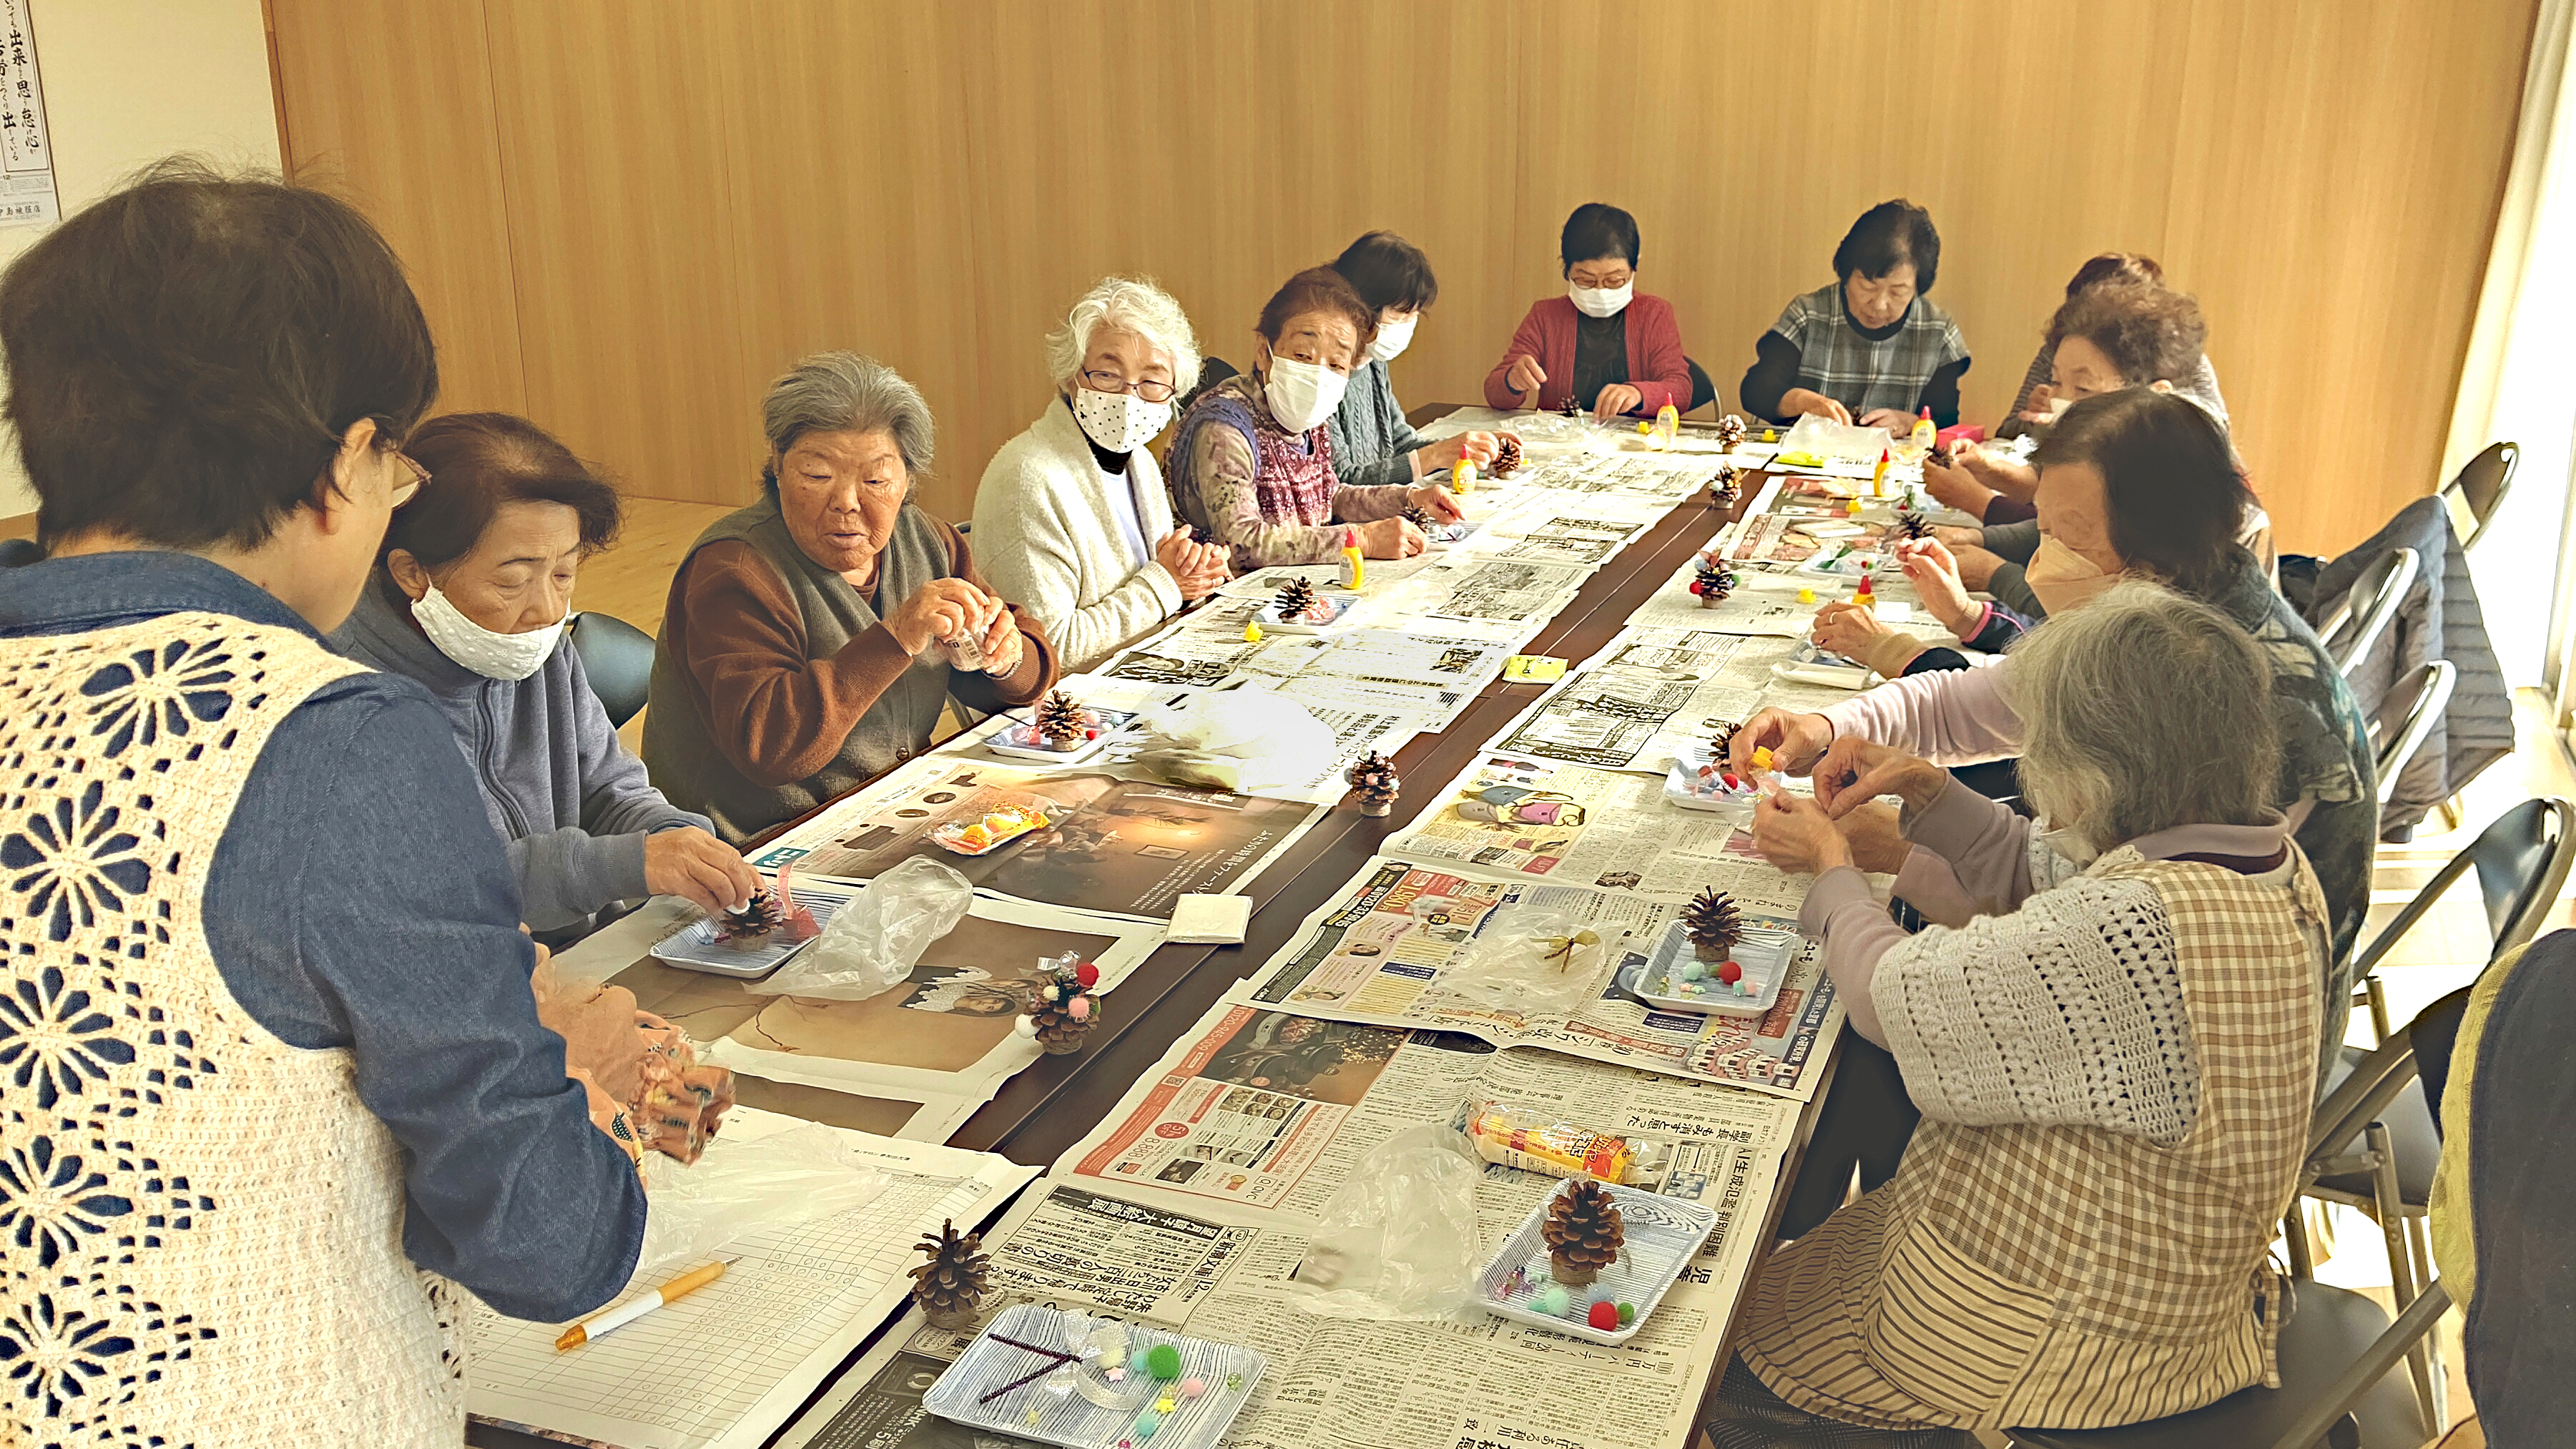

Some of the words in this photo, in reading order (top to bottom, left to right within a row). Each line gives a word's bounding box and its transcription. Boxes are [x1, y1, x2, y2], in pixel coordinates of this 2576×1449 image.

[1194, 1007, 1245, 1052] 0120-945-009
[1244, 1184, 1266, 1200] QVC
[1719, 1147, 1754, 1210] AI生成氾濫
[1083, 1196, 1161, 1225] 大絵画展
[1155, 1214, 1219, 1239] 望月諒子
[998, 1241, 1178, 1287] 女たち三百人の裏切りの書
[1191, 1241, 1238, 1278] 新潮文庫
[1093, 1272, 1171, 1295] 古川日出男
[903, 1406, 931, 1428] NHK
